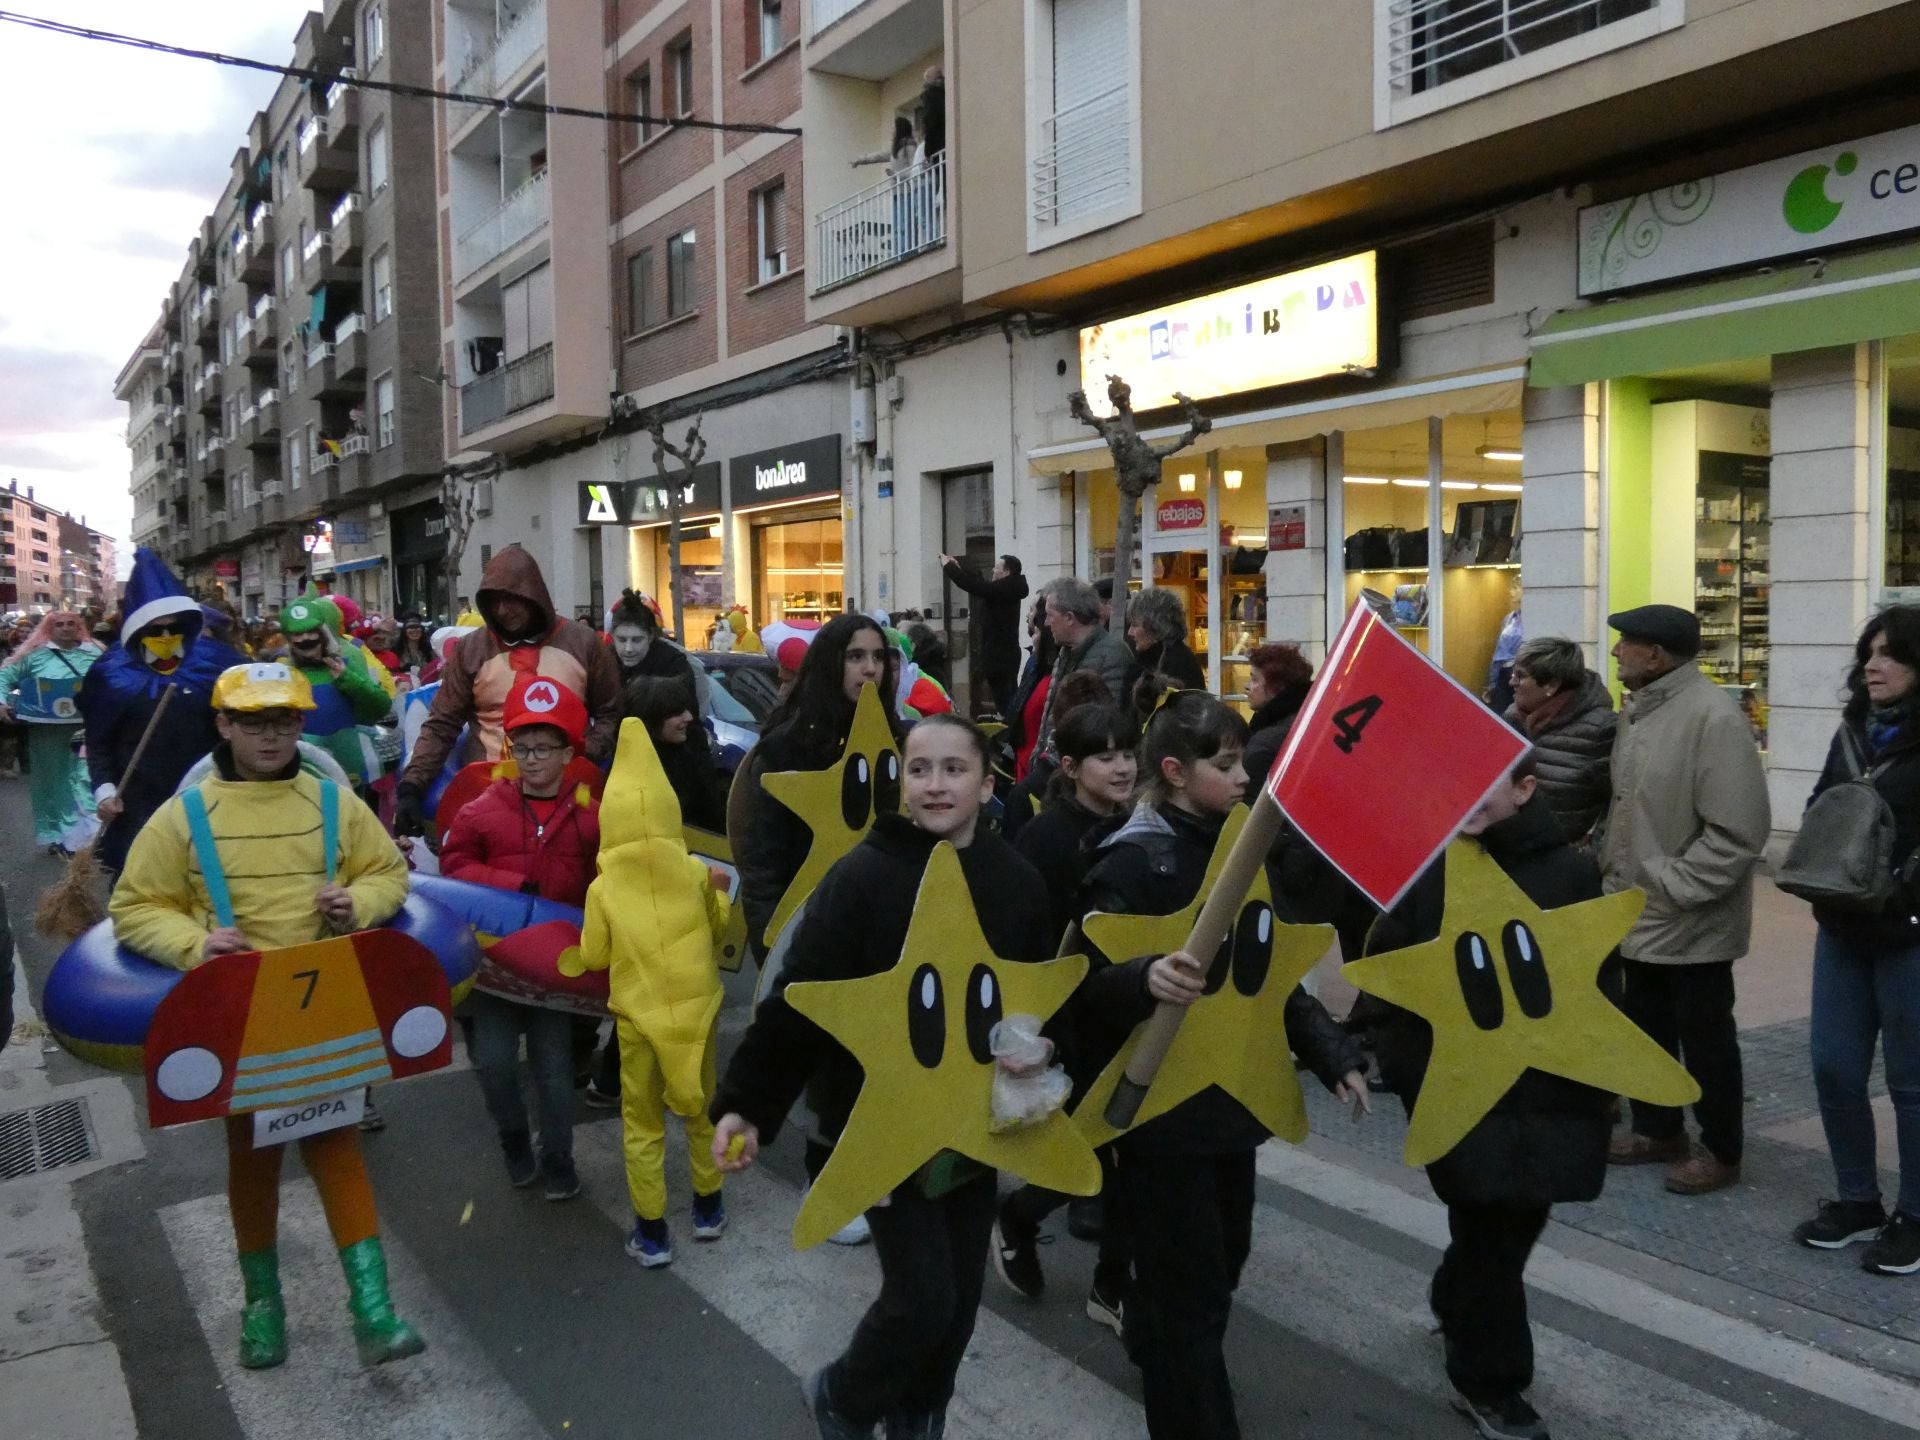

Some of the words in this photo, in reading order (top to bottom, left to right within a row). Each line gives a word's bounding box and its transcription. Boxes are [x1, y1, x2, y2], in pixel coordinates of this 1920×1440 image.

[1158, 504, 1203, 524] rebajas
[1332, 694, 1384, 754] 4
[292, 969, 320, 1009] 7
[268, 1100, 347, 1133] KOOPA
